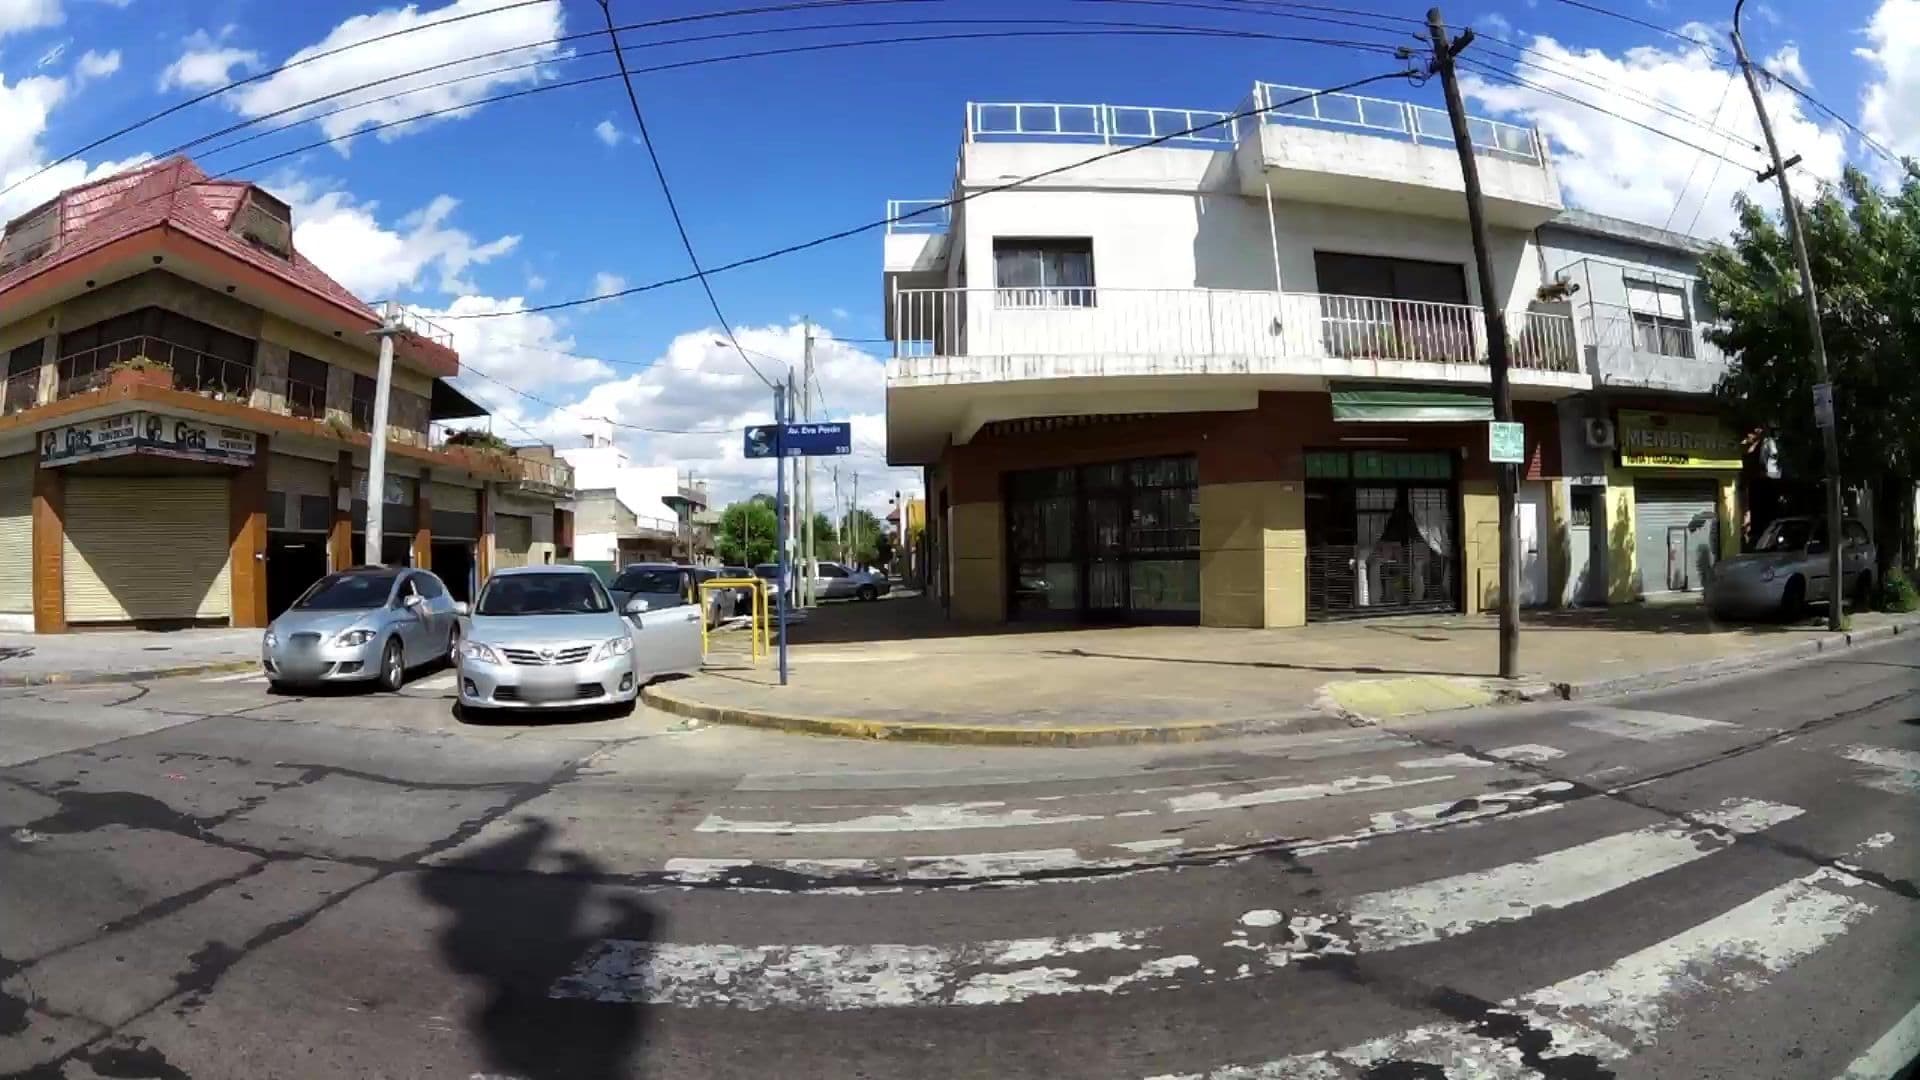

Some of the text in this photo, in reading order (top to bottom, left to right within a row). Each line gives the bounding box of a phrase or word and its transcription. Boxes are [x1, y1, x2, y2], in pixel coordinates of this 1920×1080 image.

[66, 426, 92, 455] Gas
[175, 421, 206, 449] Gas
[801, 426, 817, 434] Eva
